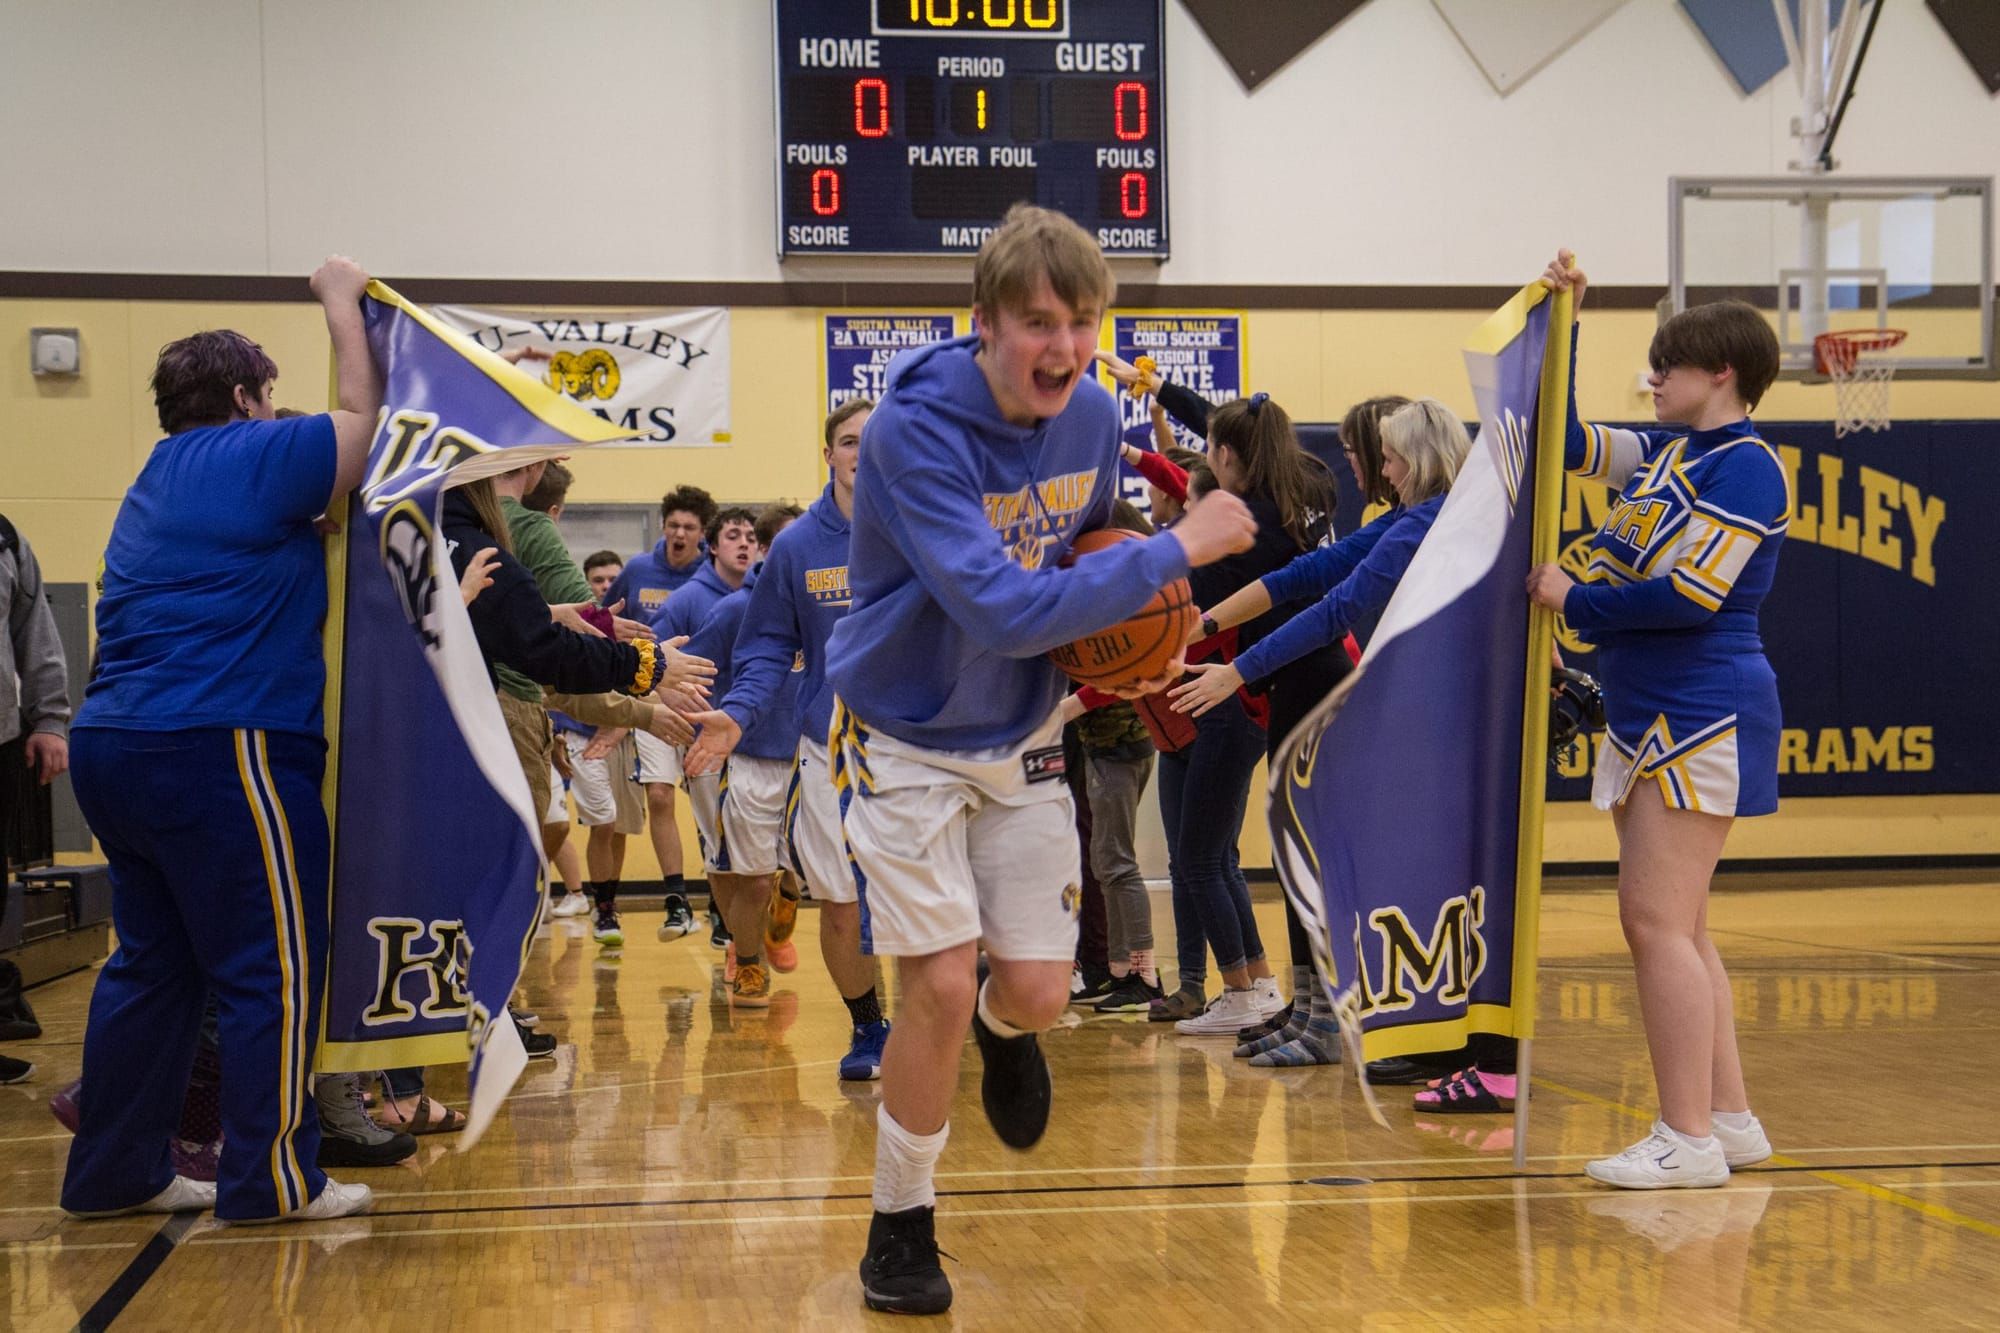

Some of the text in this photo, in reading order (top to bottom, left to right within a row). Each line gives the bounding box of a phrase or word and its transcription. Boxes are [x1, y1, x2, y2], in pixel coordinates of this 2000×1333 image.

[799, 38, 881, 67] HOME
[1055, 42, 1145, 72] GUEST
[938, 57, 1005, 77] PERIOD
[854, 78, 889, 138] 0
[976, 89, 986, 130] 1
[1114, 82, 1149, 141] 0
[786, 144, 848, 165] FOULS
[908, 147, 1037, 168] PLAYER FOUL
[1096, 149, 1156, 169] FOULS
[811, 168, 840, 216] 0
[1120, 172, 1149, 219] 0
[788, 226, 850, 246] SCORE
[941, 227, 1000, 247] MATC
[1098, 228, 1157, 248] SCORE
[846, 319, 932, 331] SUSITNA VALLEY
[1135, 321, 1219, 332] SUSITNA VALLEY
[834, 331, 942, 346] 2A VOLLEYBALL
[1133, 331, 1222, 347] COED SOCCER
[1156, 365, 1215, 390] TATE
[806, 567, 849, 592] SUSIT
[1777, 726, 1935, 774] RAMS
